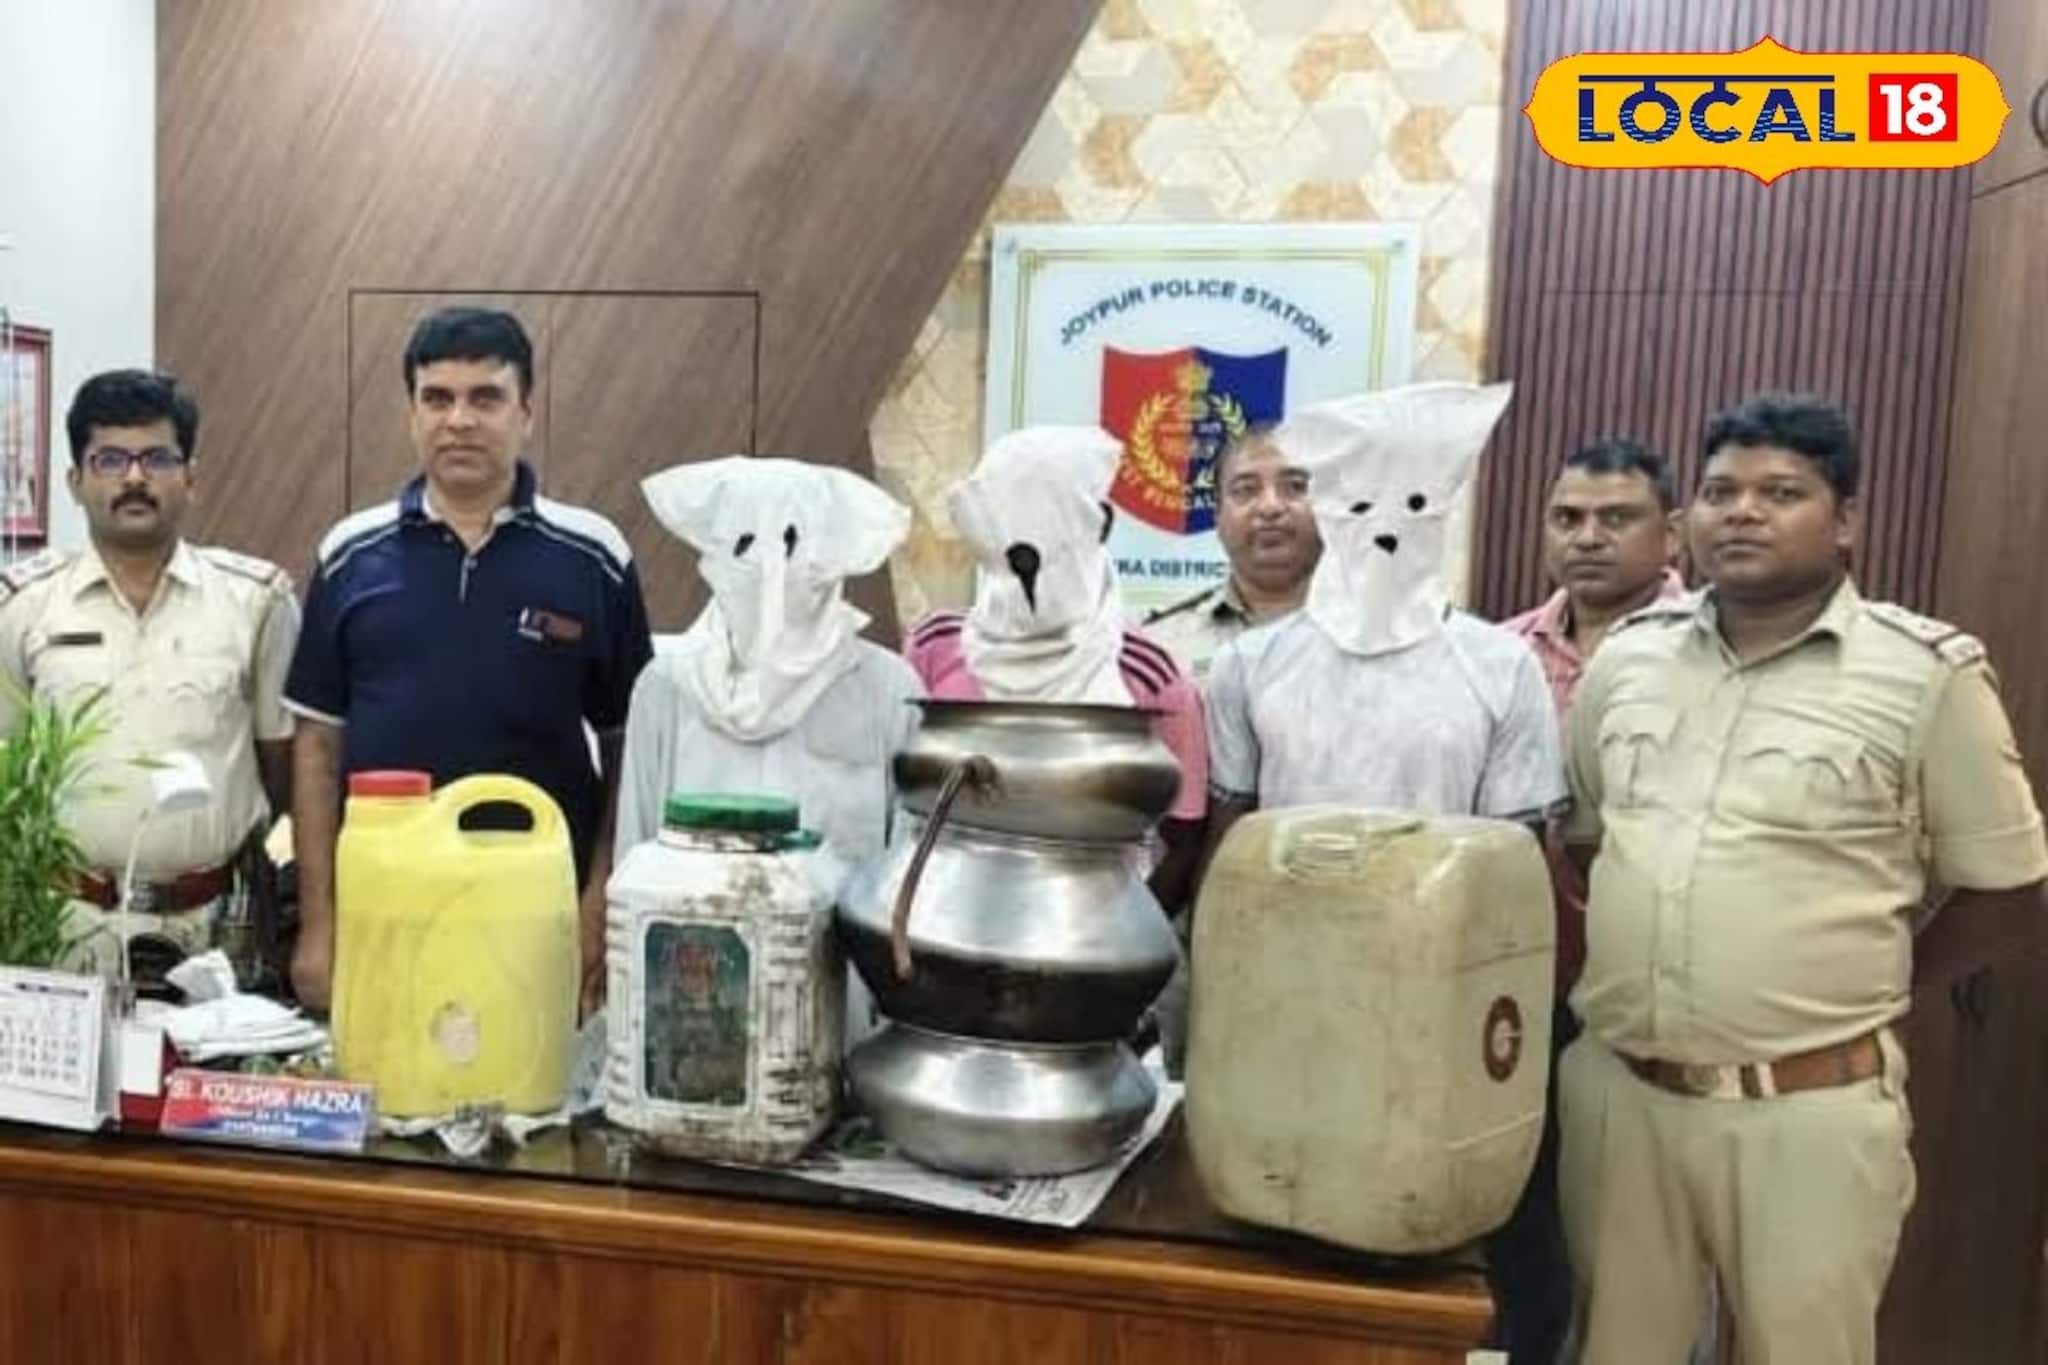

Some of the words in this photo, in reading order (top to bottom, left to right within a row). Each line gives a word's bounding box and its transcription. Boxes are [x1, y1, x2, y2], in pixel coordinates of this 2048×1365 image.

[1060, 286, 1146, 346] JOYPUR
[1150, 278, 1237, 300] POLICE
[1240, 286, 1334, 348] STATION
[1150, 560, 1226, 579] DISTRIC
[293, 1090, 363, 1115] HAZRA
